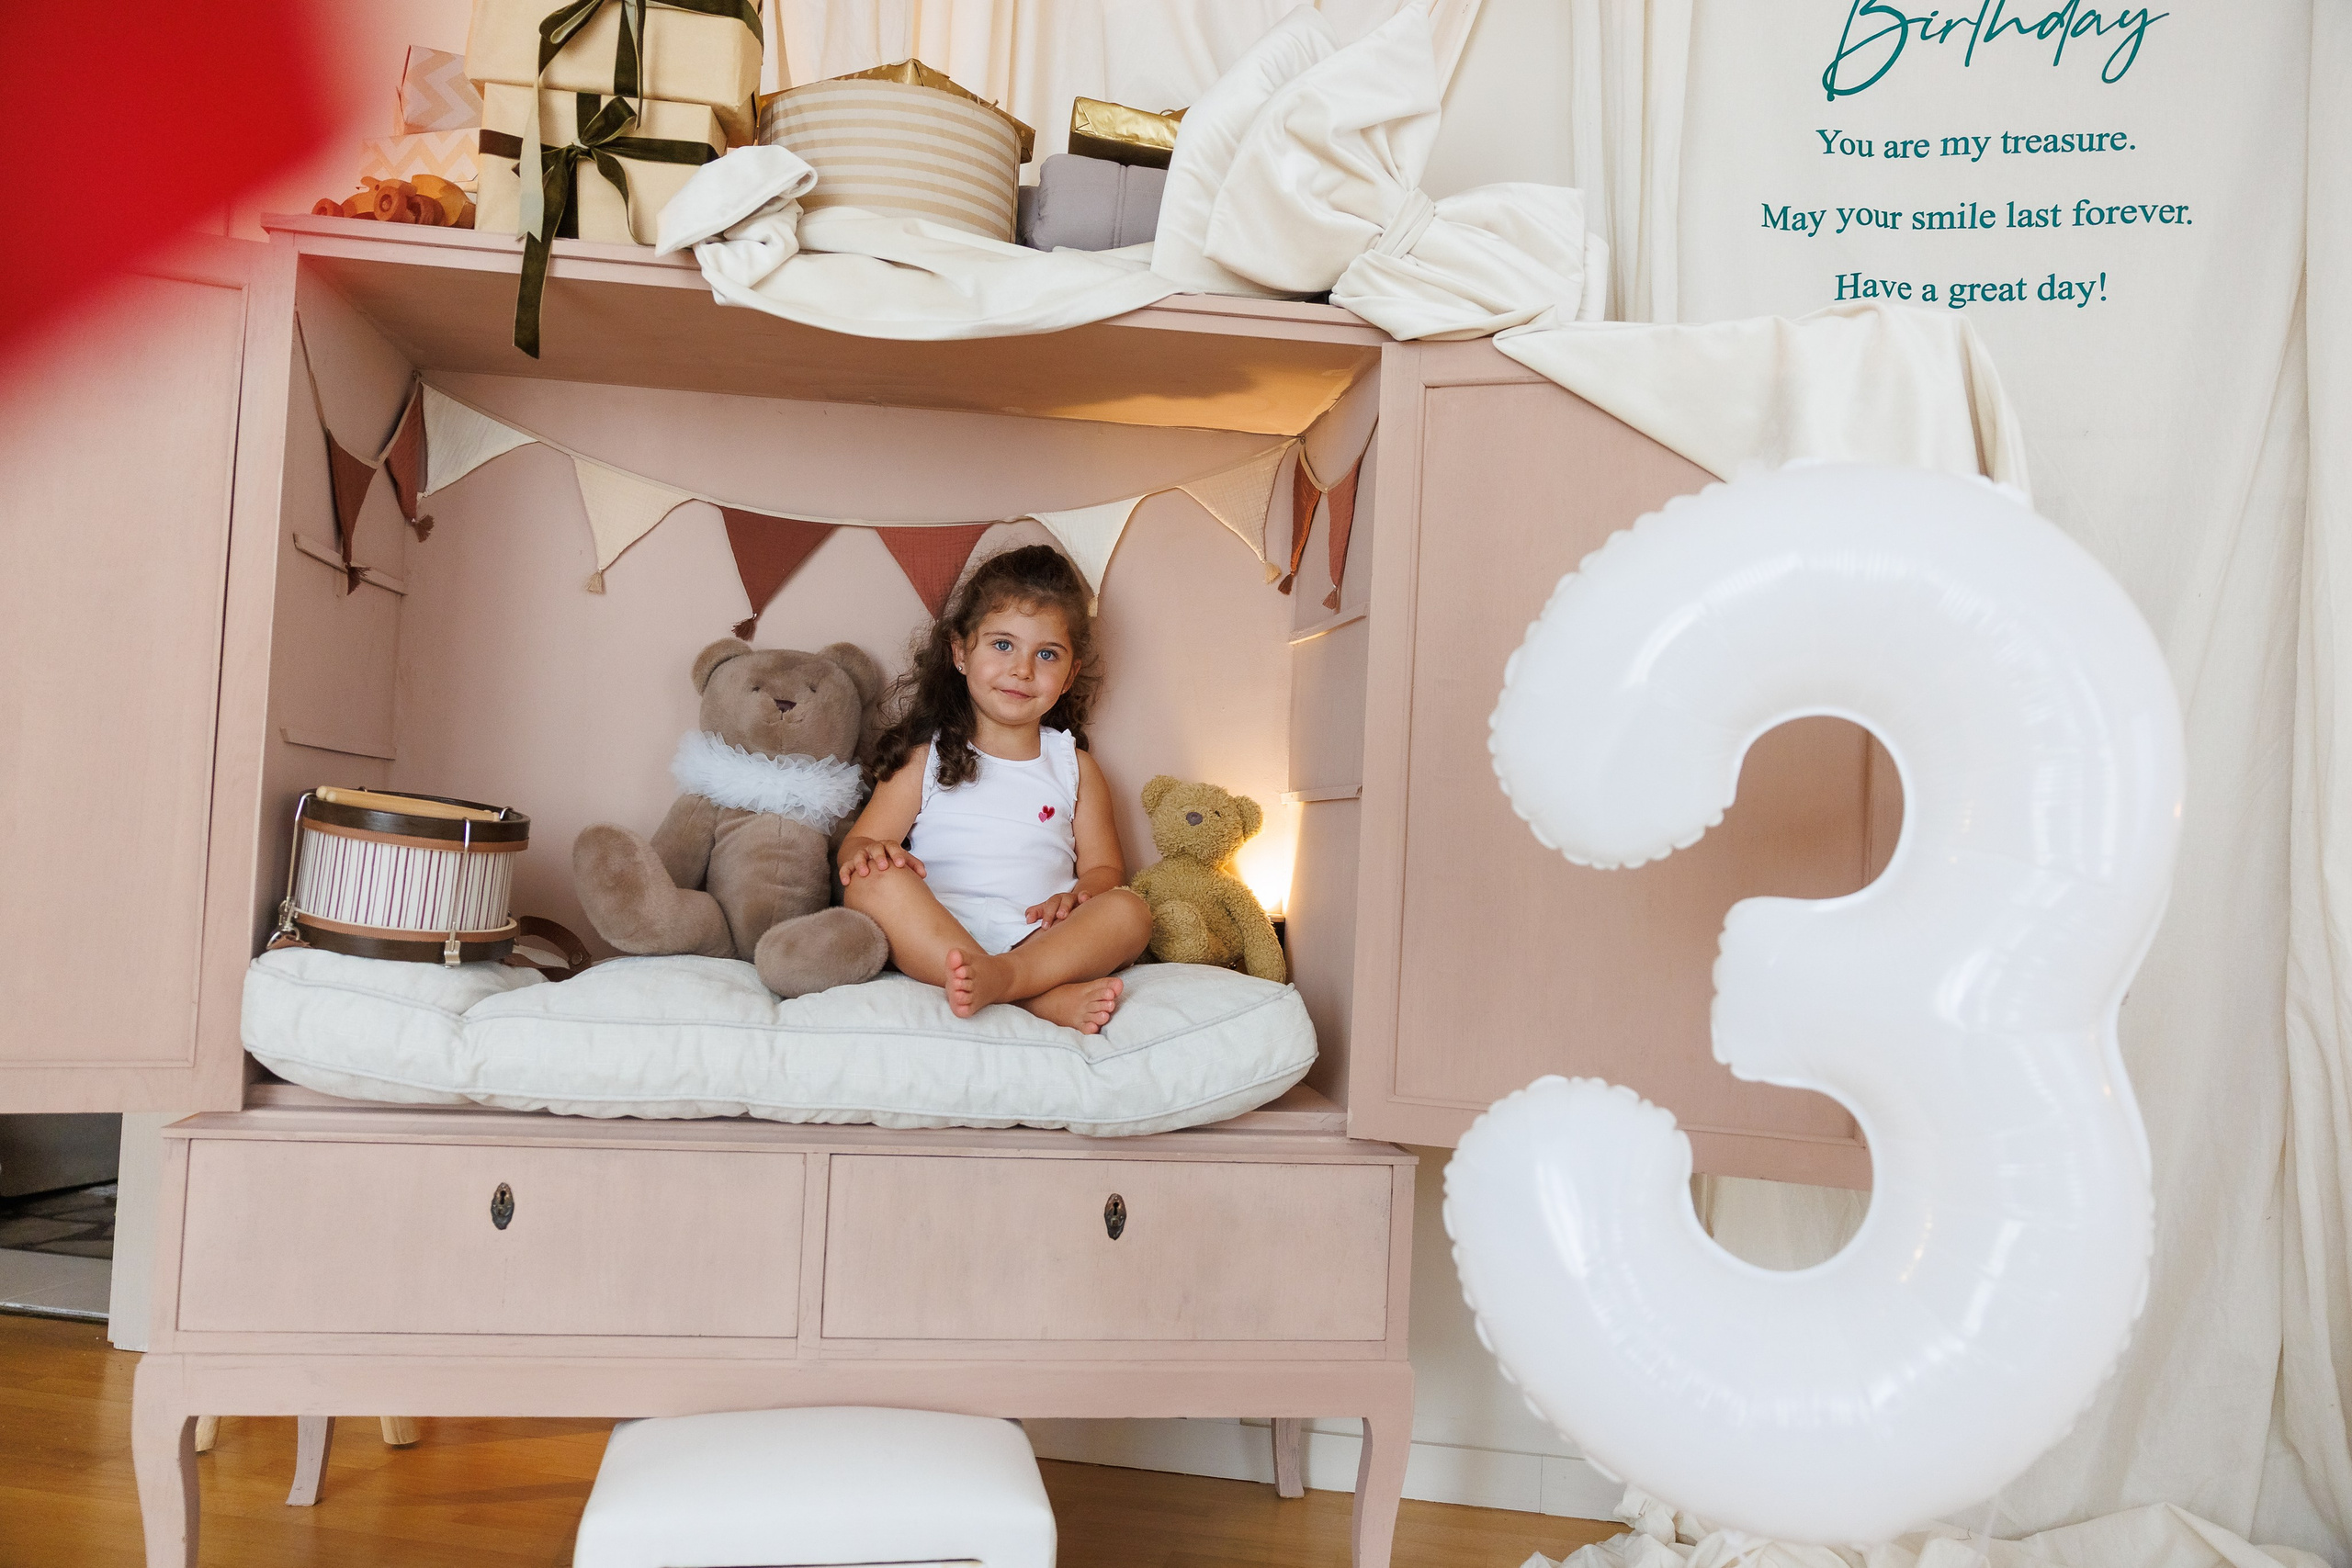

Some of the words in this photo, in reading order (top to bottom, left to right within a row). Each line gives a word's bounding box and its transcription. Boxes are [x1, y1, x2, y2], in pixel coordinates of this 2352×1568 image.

[1822, 0, 2170, 101] Birthday
[1815, 129, 1875, 158] You
[1883, 139, 1930, 160] are
[1939, 135, 1992, 164] my
[2001, 131, 2136, 154] treasure.
[1761, 203, 1826, 238] May
[1835, 207, 1903, 234] your
[1911, 202, 1996, 231] smile
[2006, 201, 2062, 229] last
[2072, 198, 2193, 227] forever.
[1834, 271, 1912, 303] Have
[1921, 284, 1939, 302] a
[1948, 277, 2028, 310] great
[2037, 271, 2108, 309] day!
[1443, 458, 2185, 1547] 3
